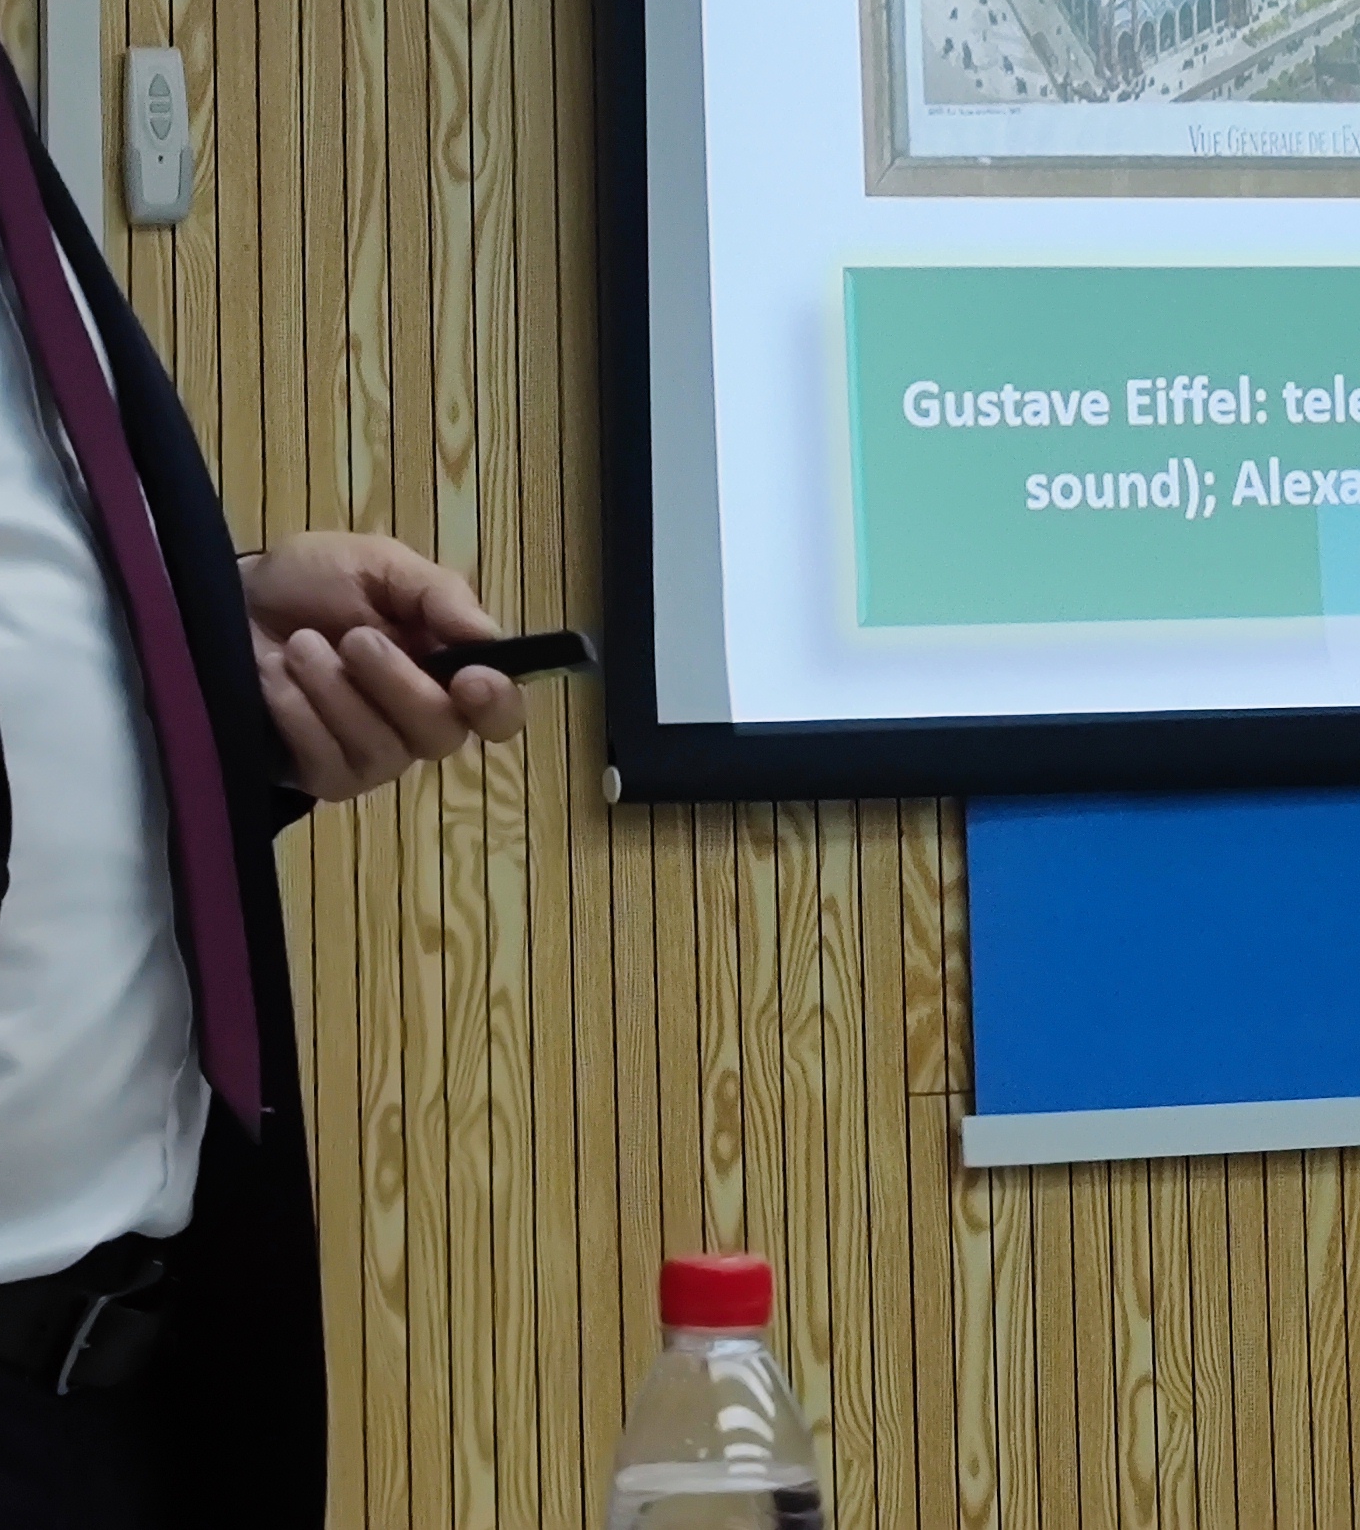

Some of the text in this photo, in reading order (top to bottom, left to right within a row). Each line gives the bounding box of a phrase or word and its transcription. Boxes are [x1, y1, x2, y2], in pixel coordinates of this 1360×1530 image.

[902, 379, 1110, 428] Gustave
[1127, 375, 1268, 426] Eiffel:
[1026, 458, 1217, 520] sound);
